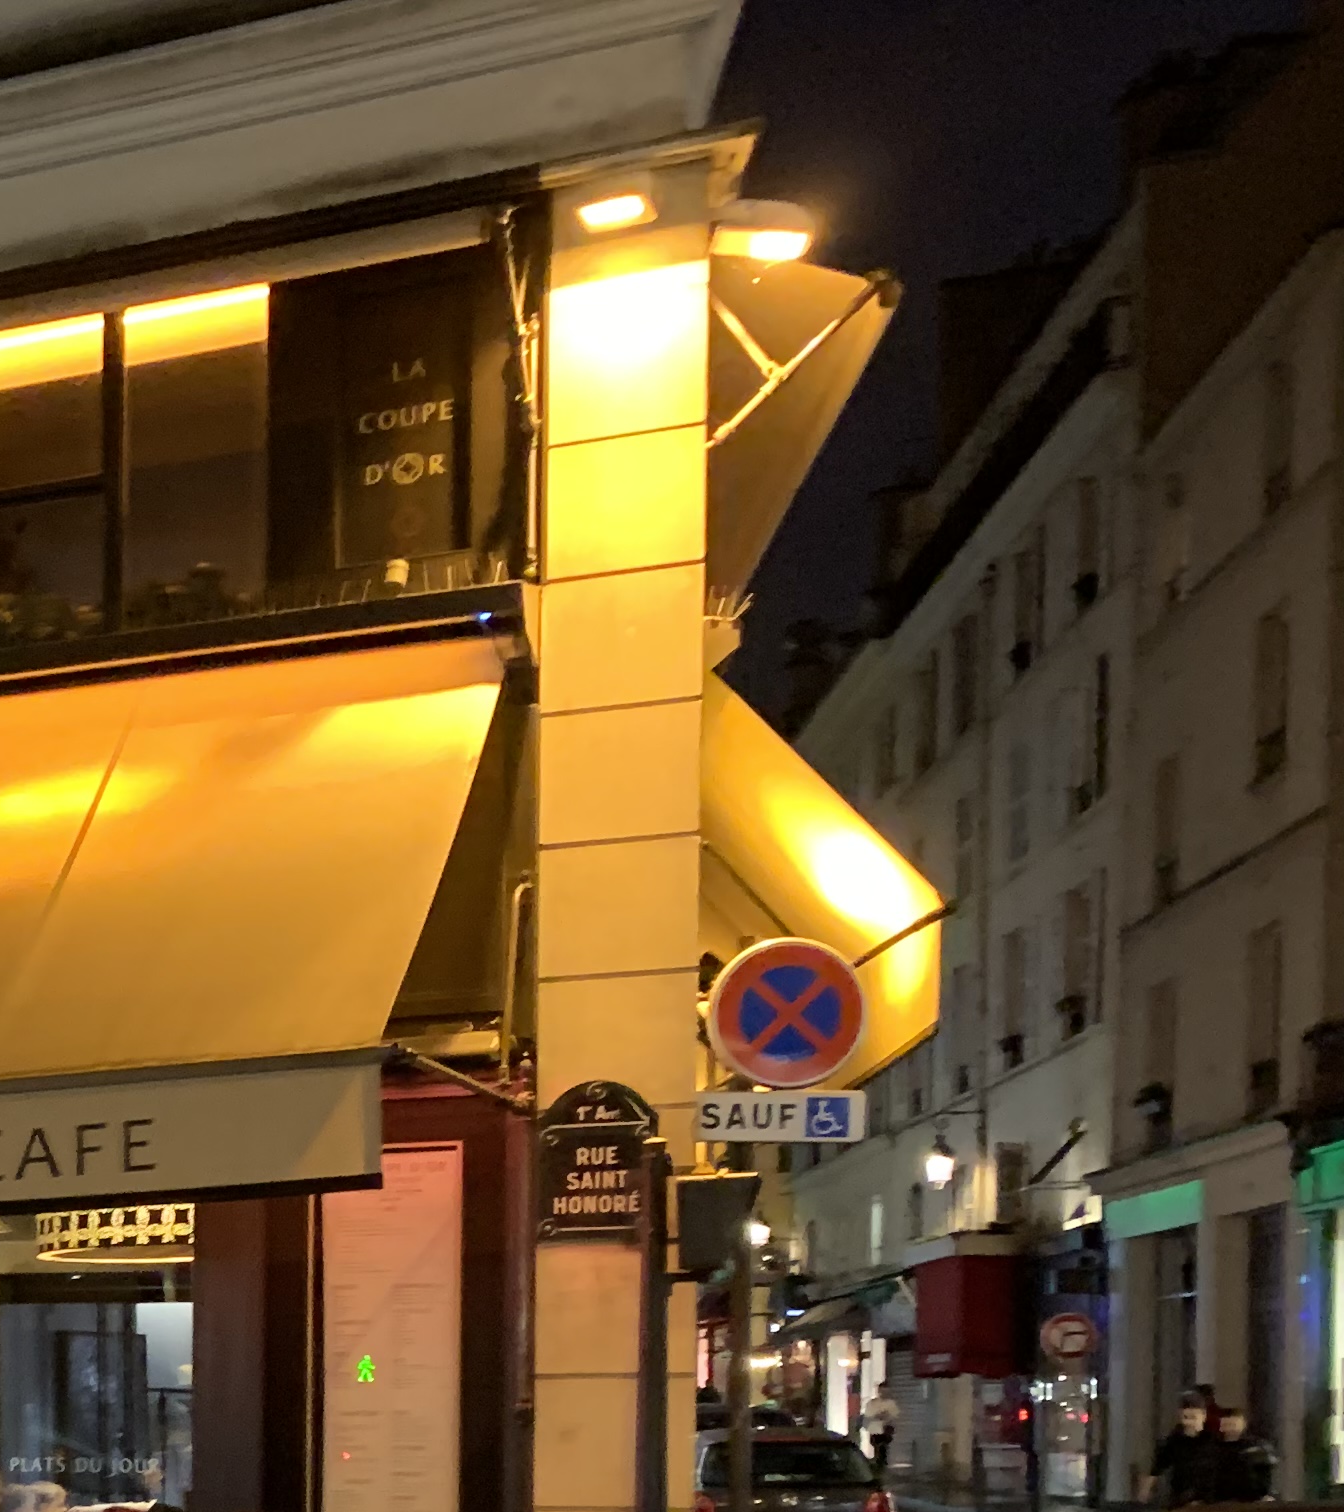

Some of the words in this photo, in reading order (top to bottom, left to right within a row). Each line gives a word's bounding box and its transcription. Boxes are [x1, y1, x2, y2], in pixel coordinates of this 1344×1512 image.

[391, 357, 427, 384] LA
[358, 397, 456, 435] COUPE
[700, 1101, 798, 1131] SAUF
[576, 1145, 618, 1166] RUE
[566, 1168, 628, 1190] SAINT
[552, 1189, 642, 1215] HONORÉ
[9, 1455, 66, 1473] PLATS
[75, 1456, 103, 1473] DU
[105, 1457, 160, 1478] JOUR
